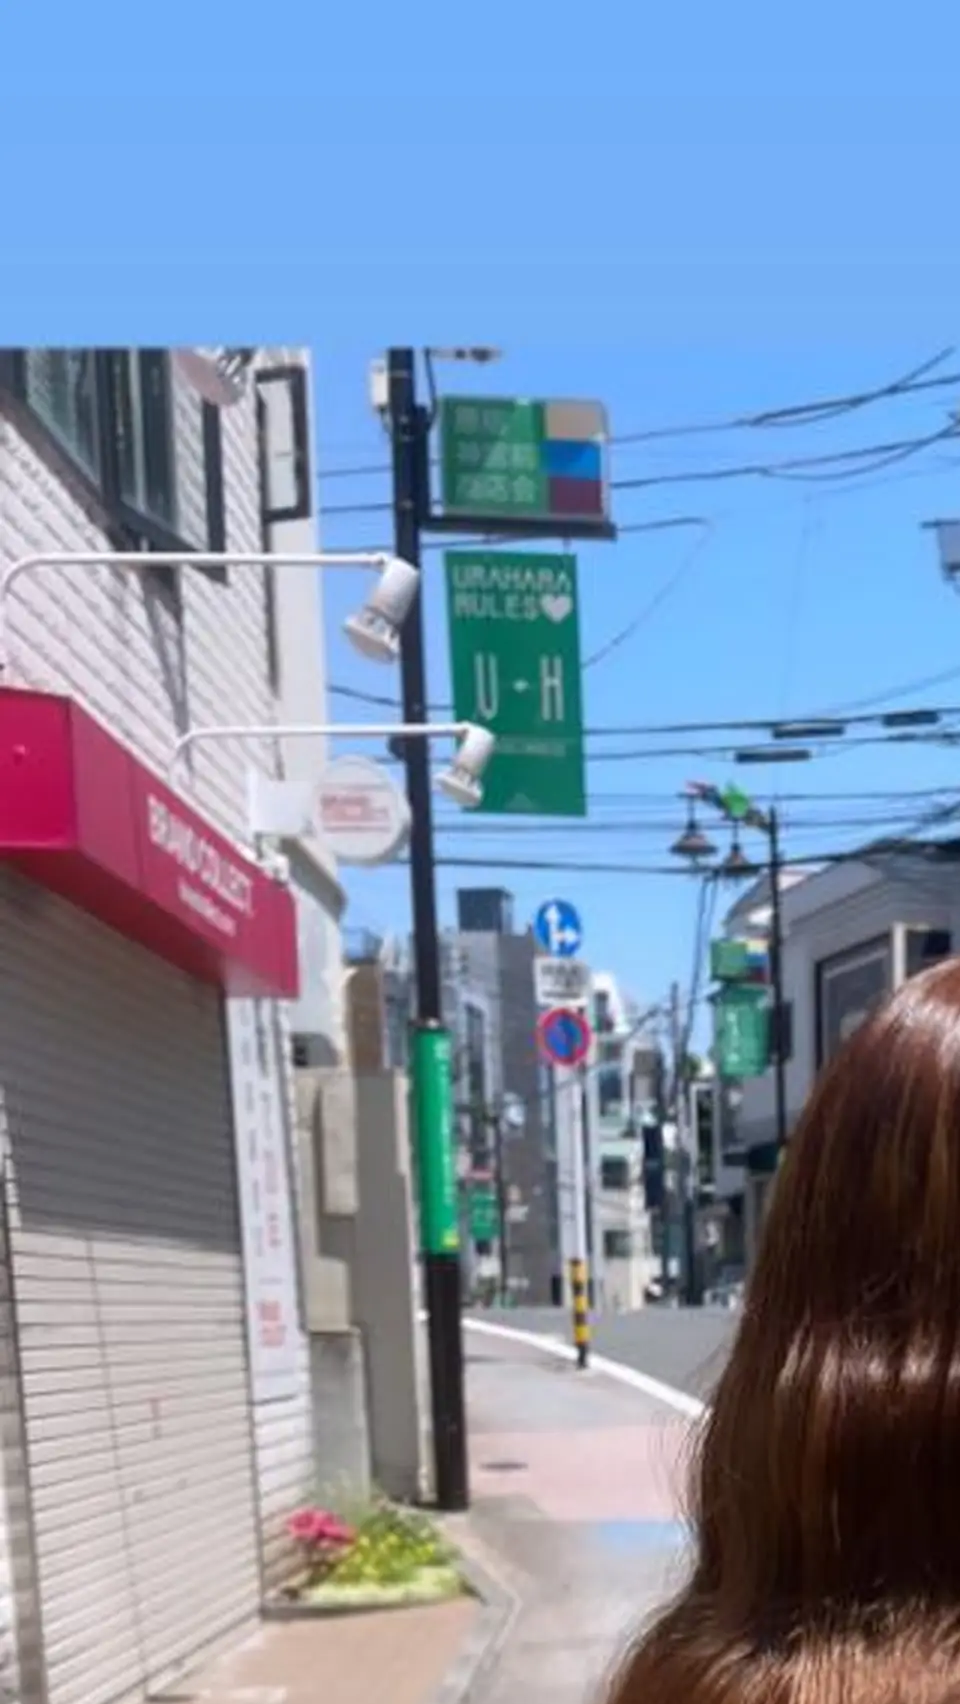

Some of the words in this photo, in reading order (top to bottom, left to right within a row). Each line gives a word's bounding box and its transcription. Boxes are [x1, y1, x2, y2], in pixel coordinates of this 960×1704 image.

[452, 563, 573, 593] URAHARA
[453, 591, 541, 621] RULES
[474, 652, 499, 721] U
[539, 654, 564, 722] H
